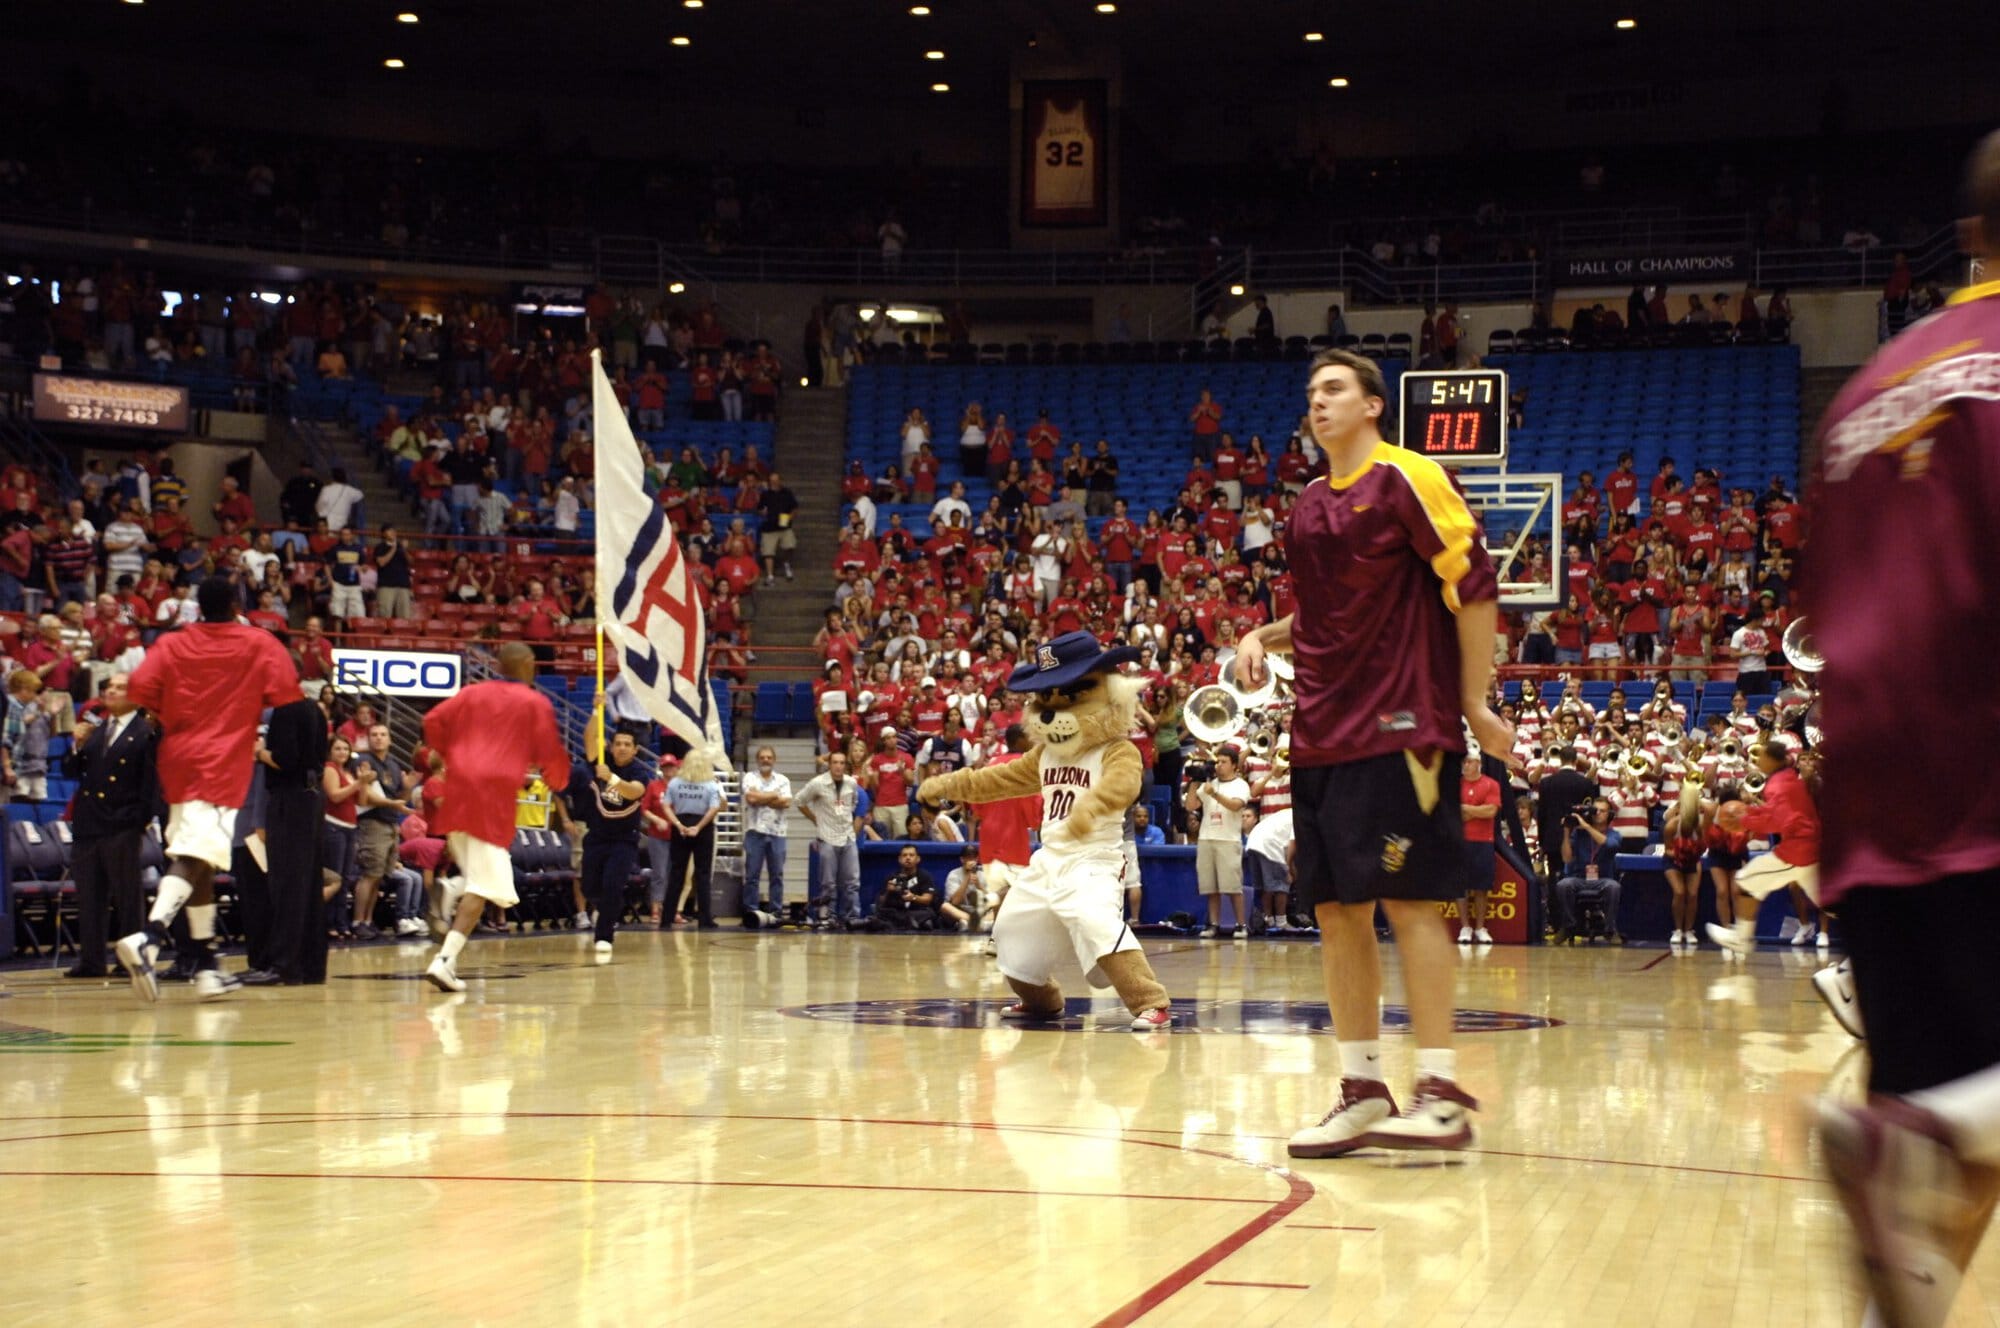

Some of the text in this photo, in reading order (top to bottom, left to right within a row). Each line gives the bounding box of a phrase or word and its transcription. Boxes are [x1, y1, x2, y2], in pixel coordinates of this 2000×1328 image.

[1046, 140, 1084, 167] 32
[1570, 256, 1734, 275] HALL OF CHAMPIONS
[1431, 380, 1492, 404] 5:47
[67, 404, 159, 425] 327-7463
[1426, 412, 1480, 451] 00
[337, 657, 456, 690] EICO
[1043, 766, 1090, 788] ARIZONA
[1049, 789, 1076, 820] 00
[1434, 901, 1516, 920] FAGO
